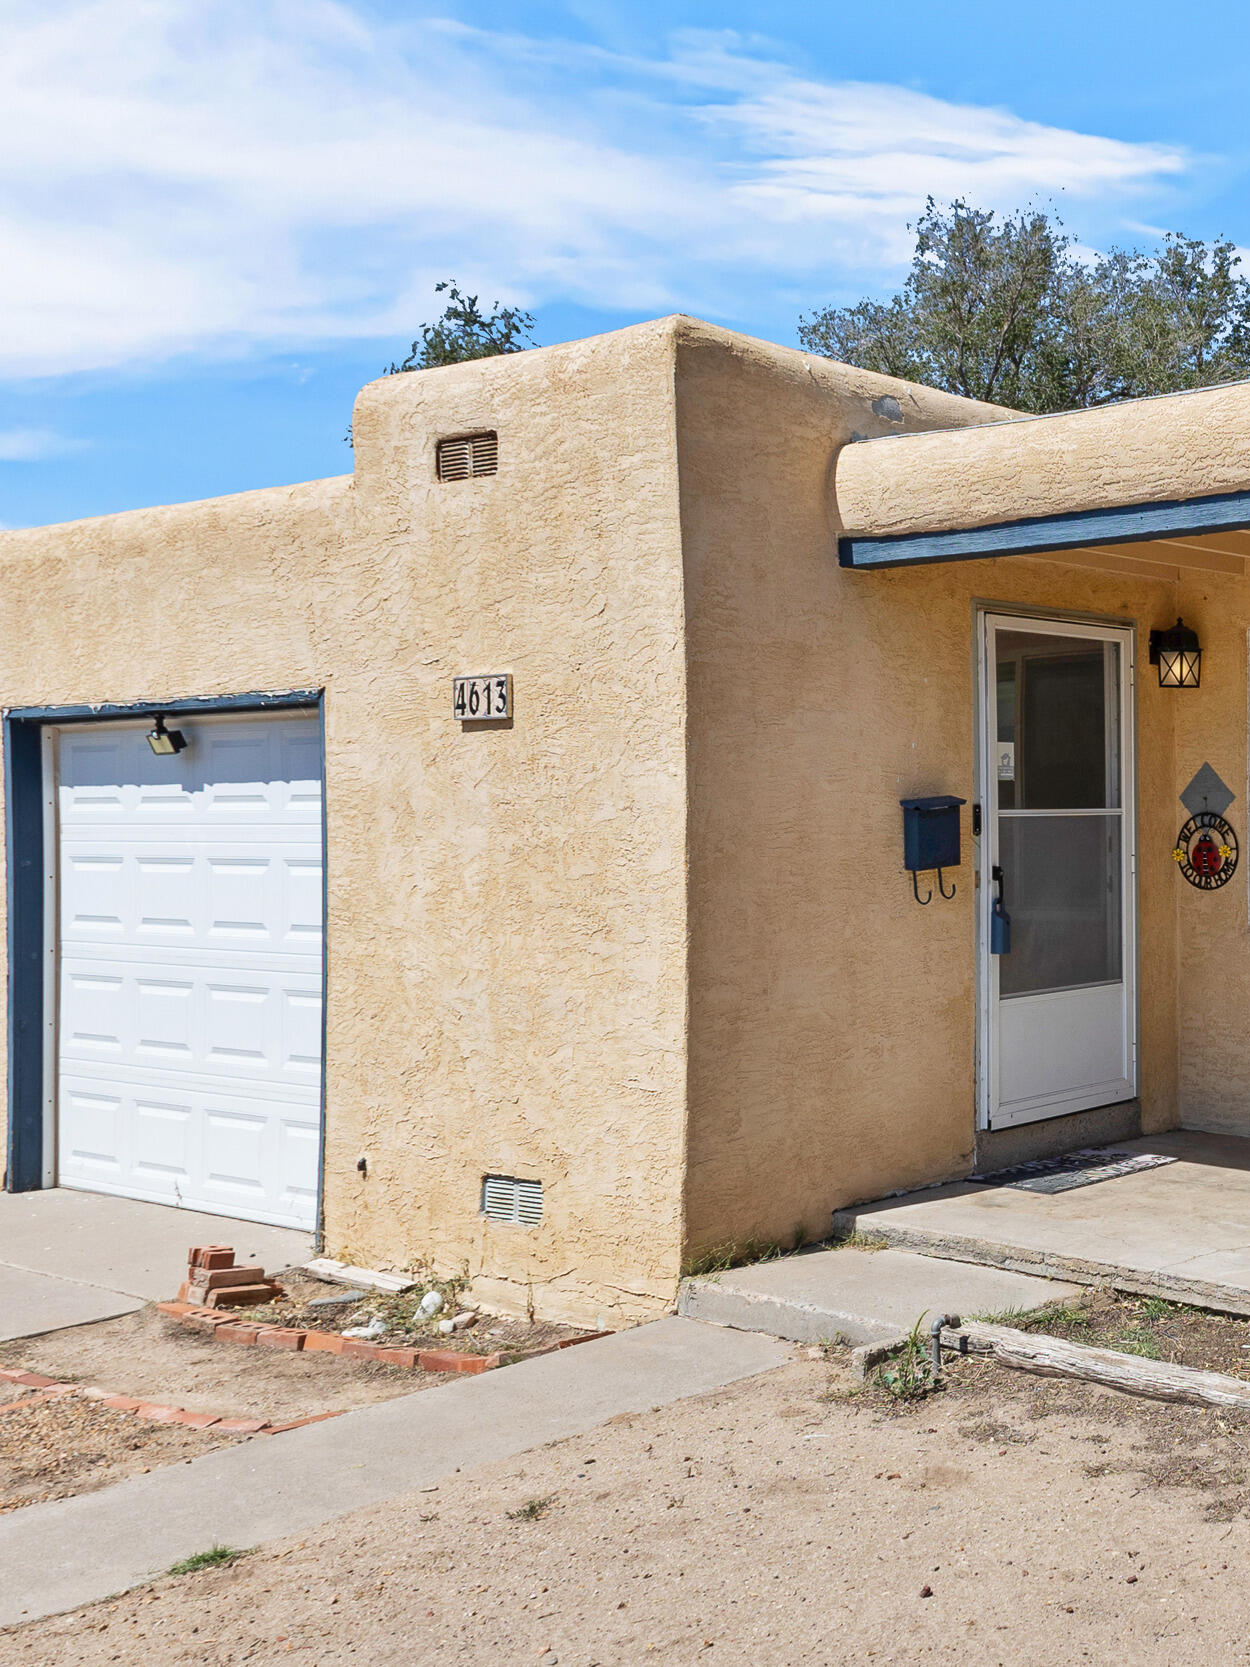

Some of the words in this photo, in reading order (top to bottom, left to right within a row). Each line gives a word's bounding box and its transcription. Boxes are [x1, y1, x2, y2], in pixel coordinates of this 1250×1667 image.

[455, 681, 507, 716] 4613
[1179, 814, 1231, 843] WELCOME
[1181, 864, 1194, 879] TO
[1193, 875, 1213, 889] OUR
[1213, 859, 1235, 887] HOME
